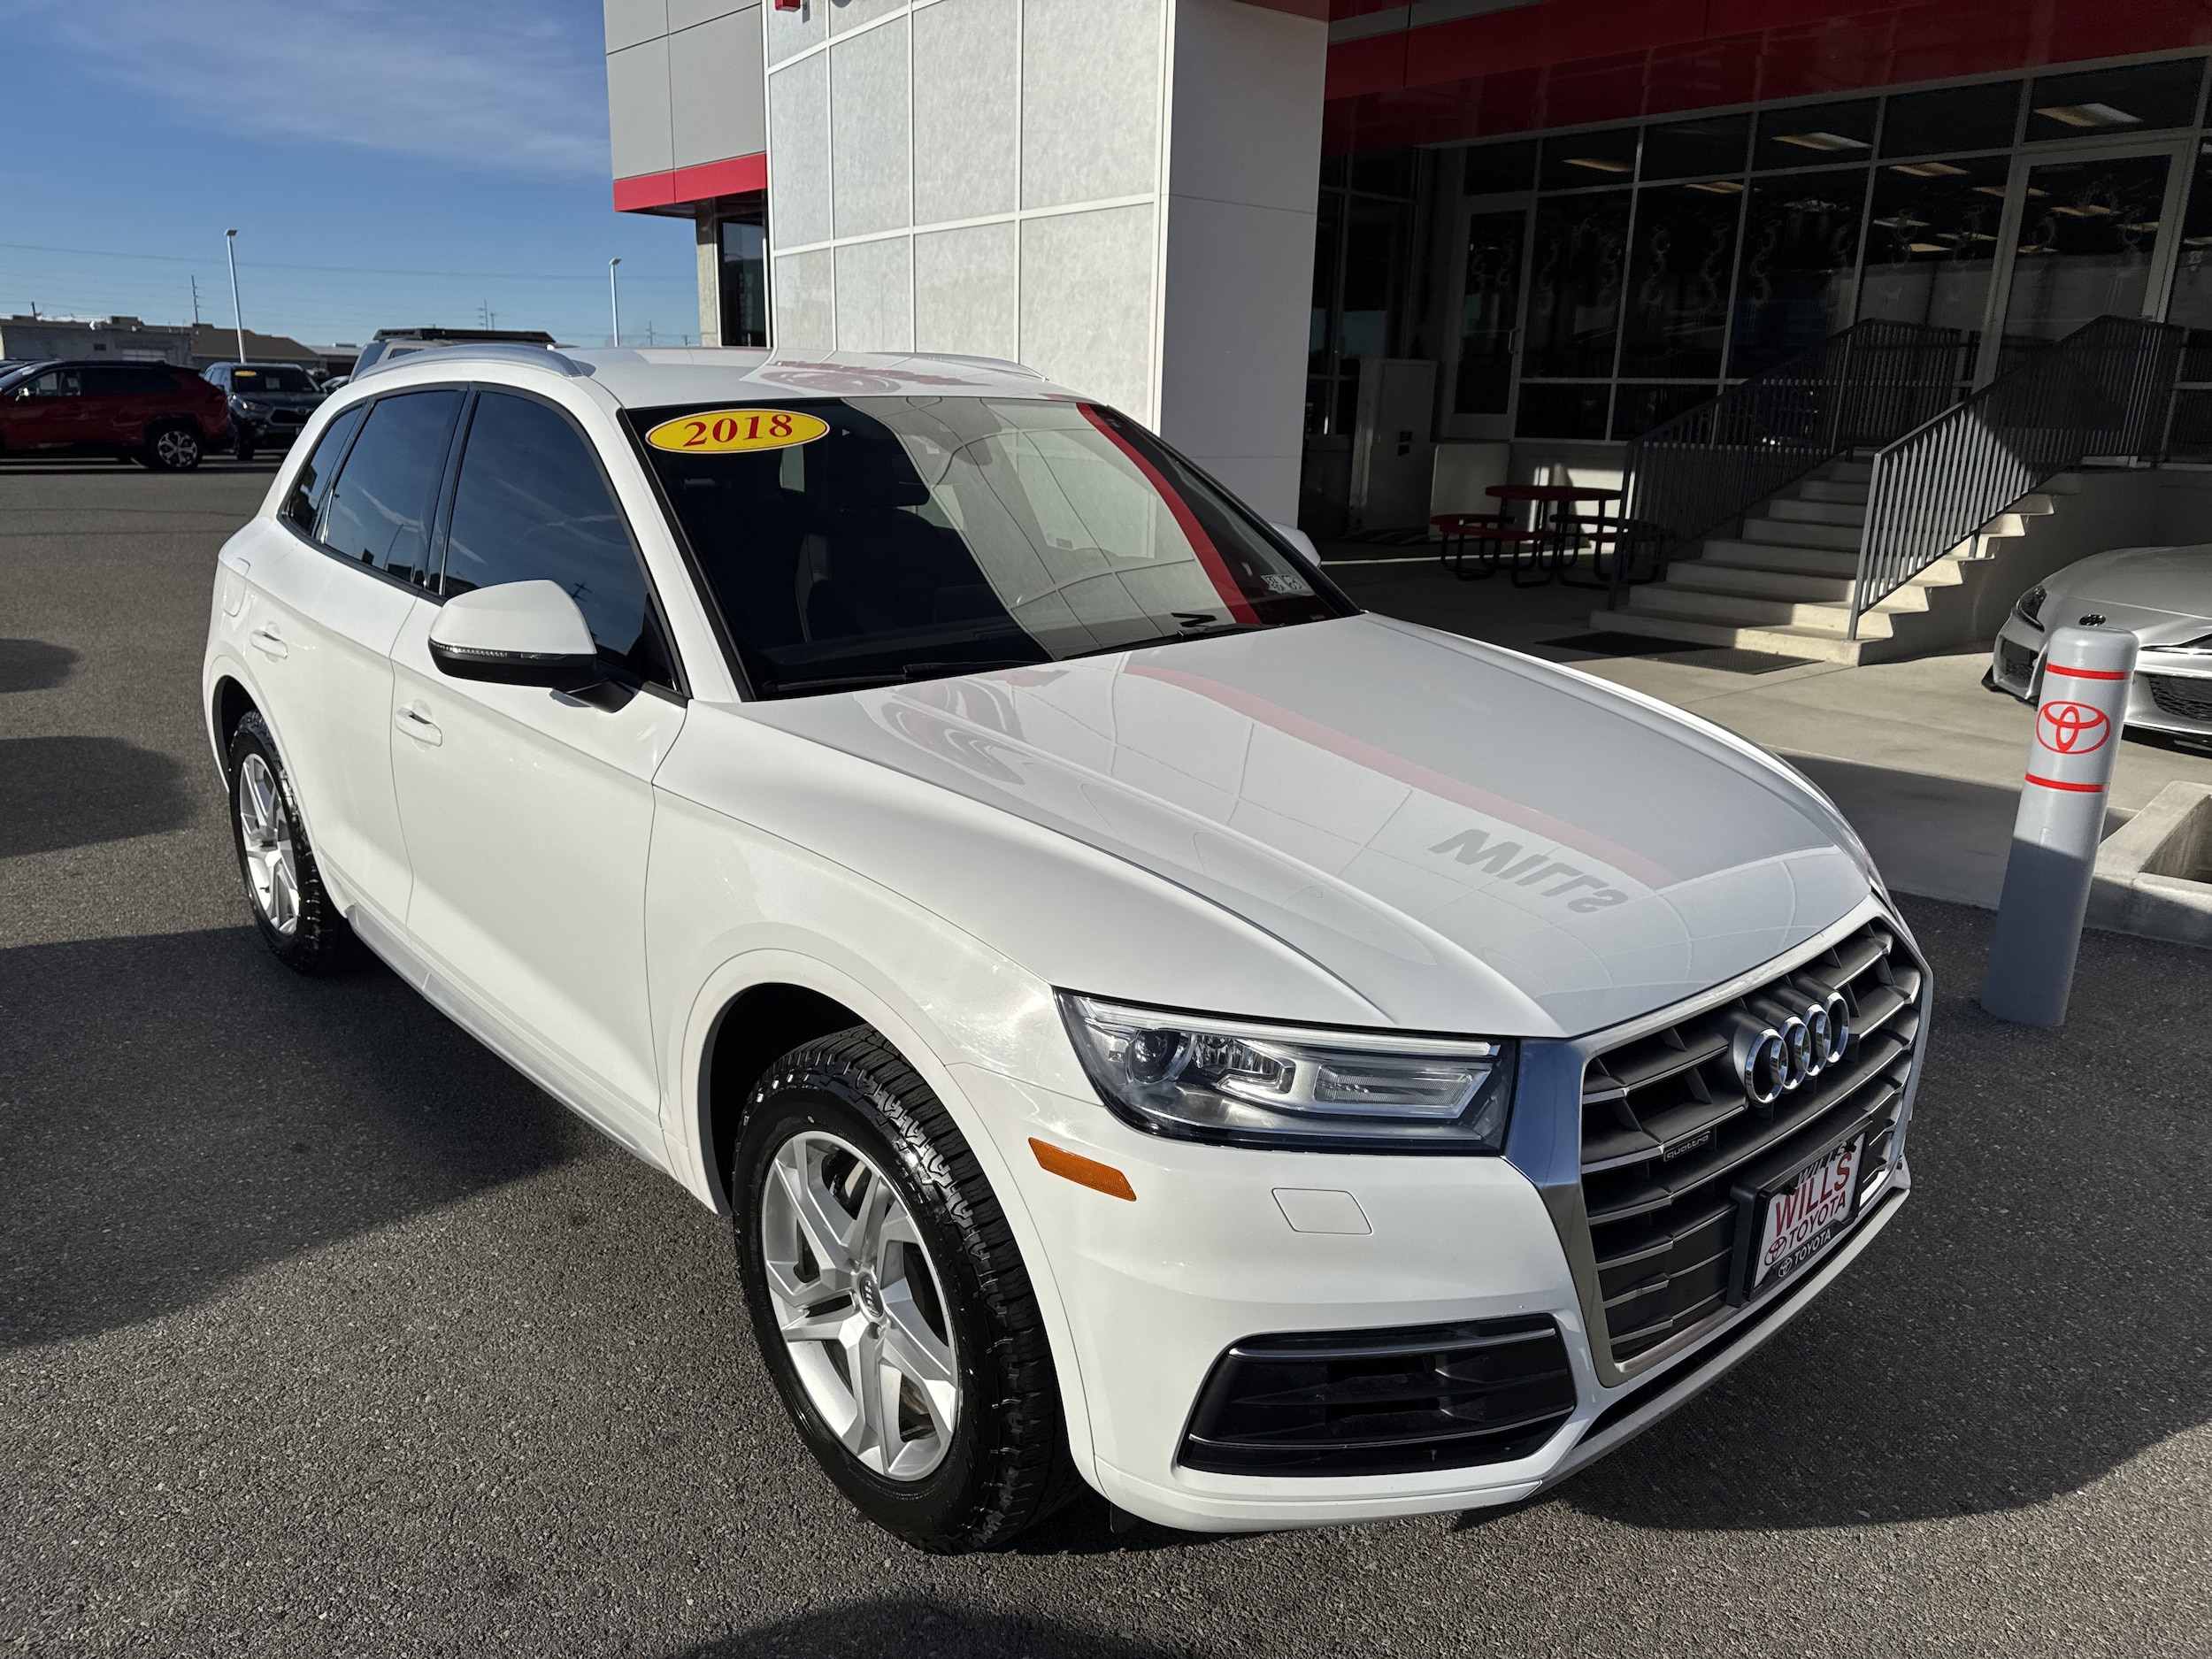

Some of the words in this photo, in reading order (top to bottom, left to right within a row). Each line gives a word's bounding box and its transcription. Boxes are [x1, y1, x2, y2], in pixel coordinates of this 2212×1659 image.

[683, 414, 793, 448] 2018
[1666, 1134, 1709, 1158] quattro
[1775, 1152, 1852, 1237] WILLS
[1788, 1190, 1847, 1249] TOYOTA
[1793, 1228, 1832, 1265] TOYOTA
